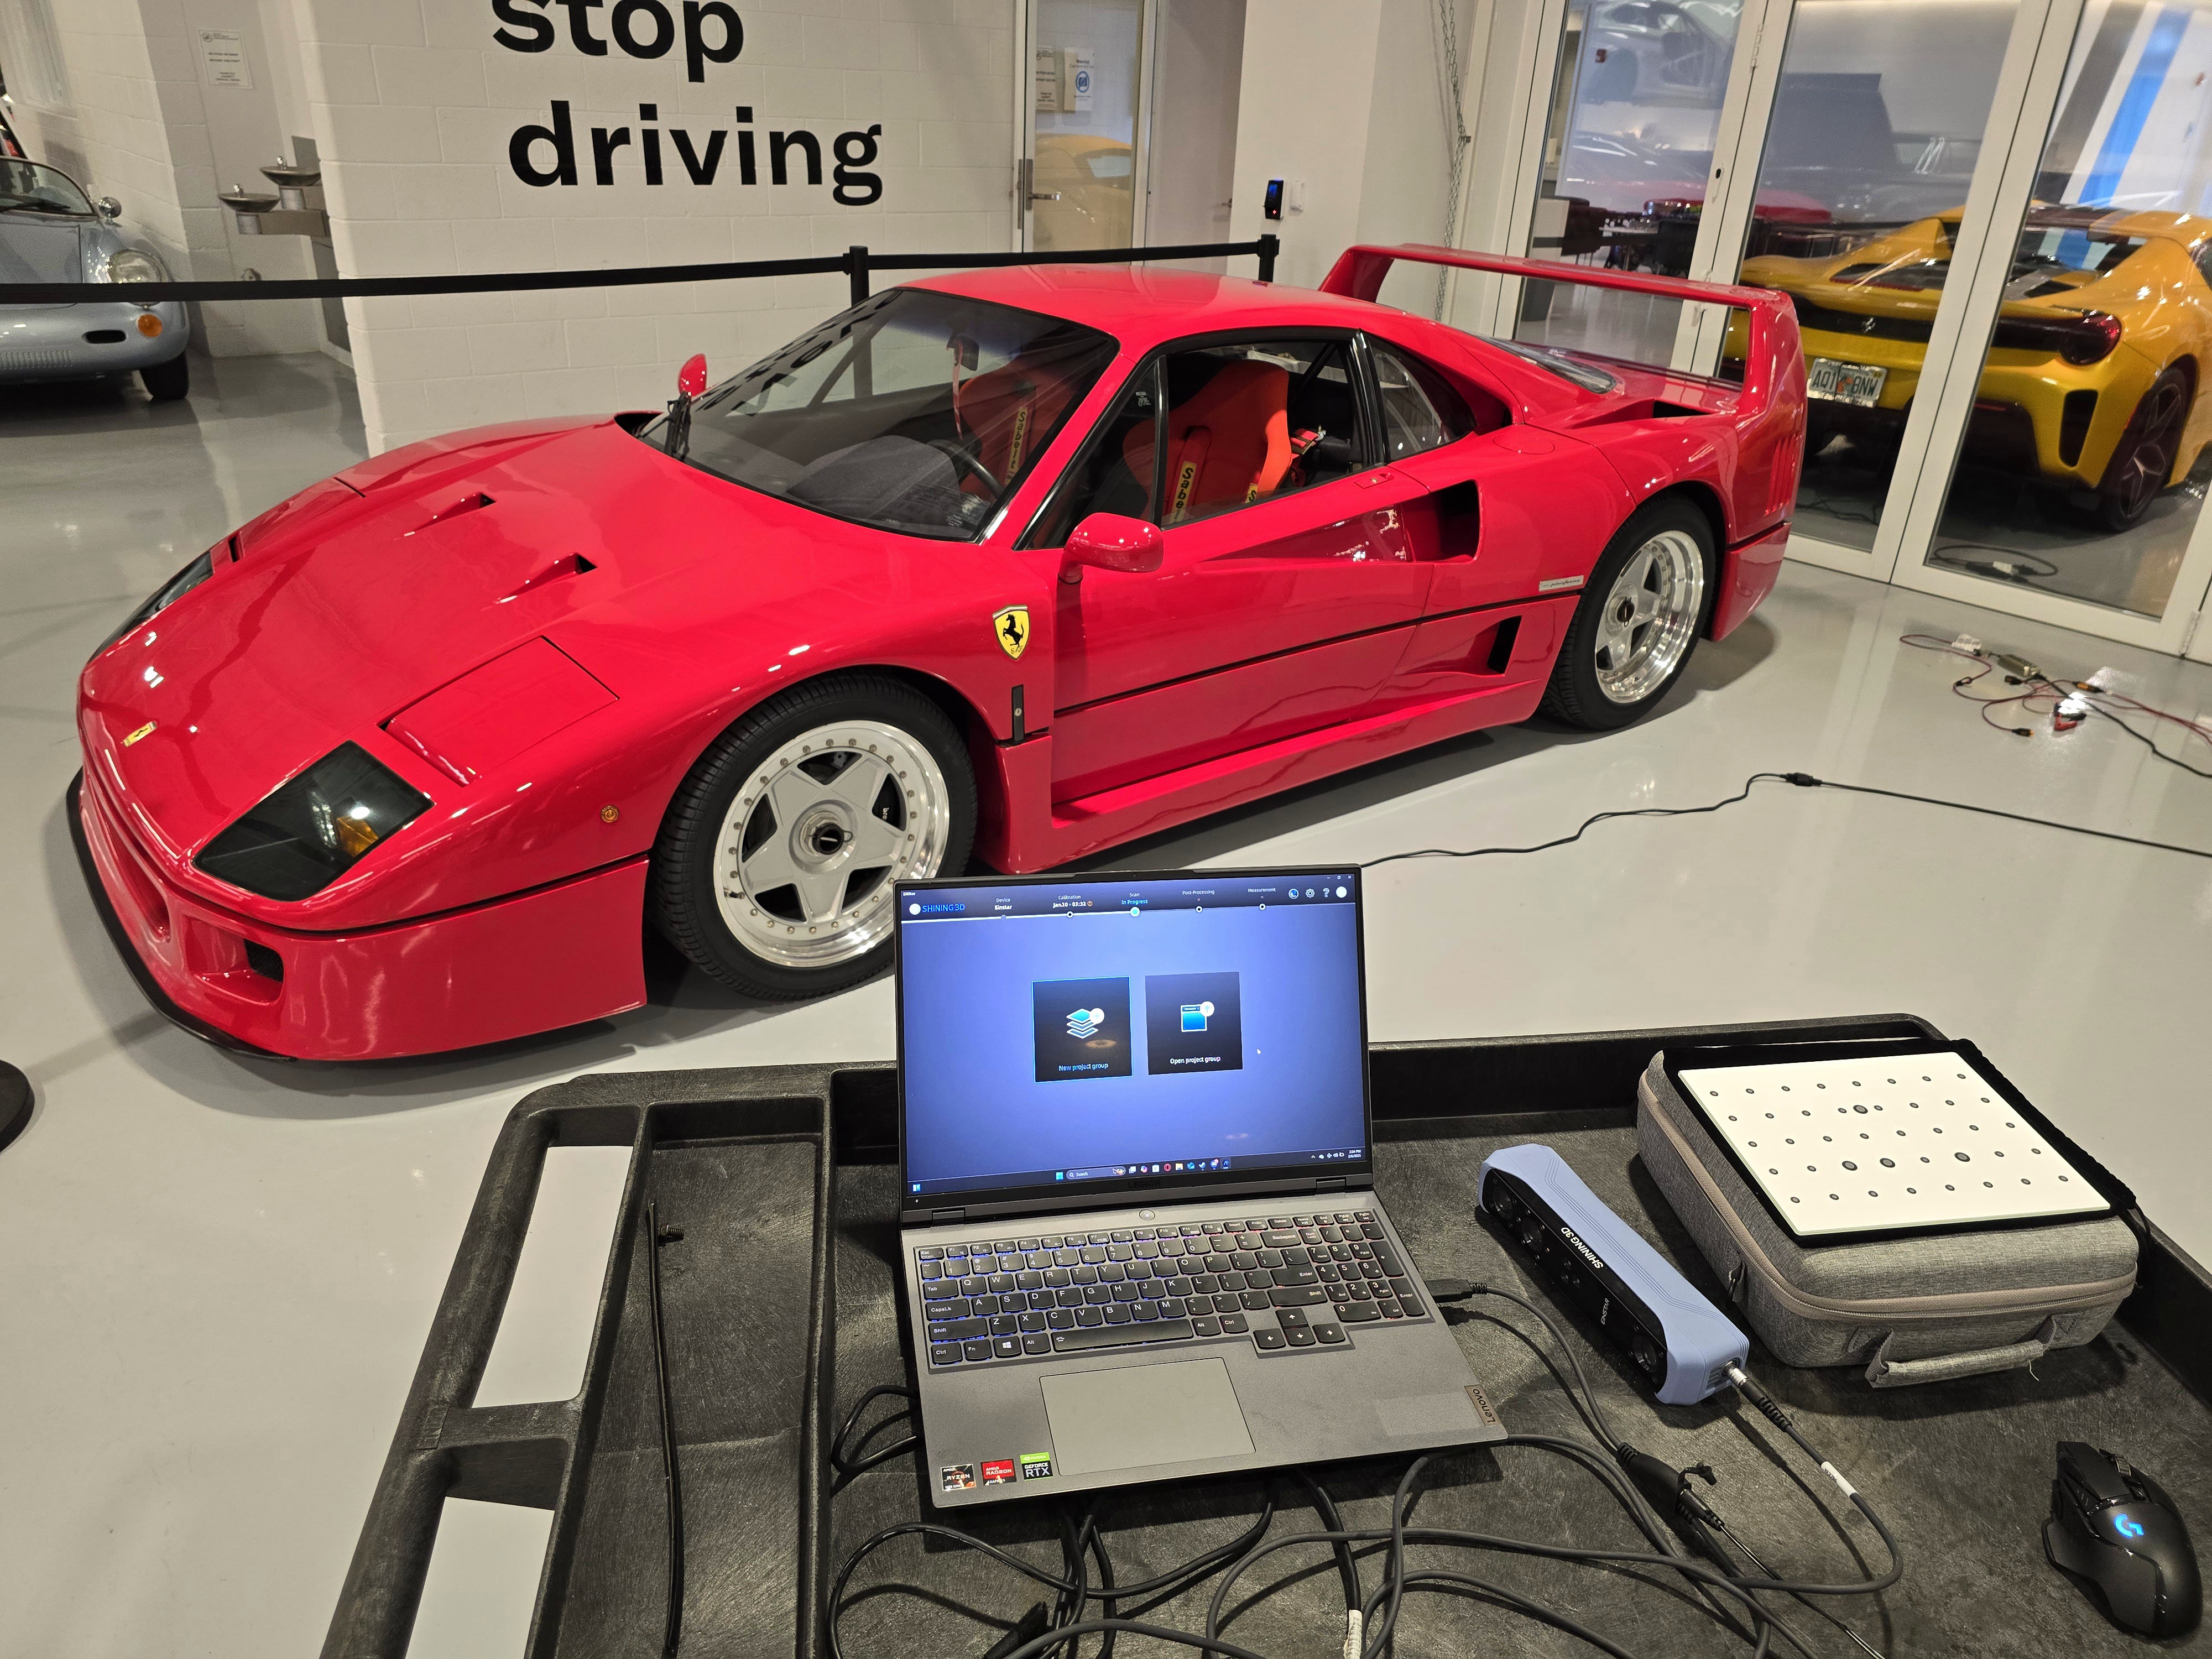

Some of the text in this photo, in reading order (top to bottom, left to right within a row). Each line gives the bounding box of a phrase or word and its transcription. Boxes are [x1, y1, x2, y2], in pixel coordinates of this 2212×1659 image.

[492, 0, 744, 82] stop
[509, 100, 883, 206] driving
[1011, 411, 1026, 469] Sabelt
[1174, 467, 1193, 522] Sabel
[922, 904, 954, 912] SHINING
[1128, 1179, 1161, 1188] LEGION
[1561, 1227, 1604, 1269] SHINING 3D
[1600, 1297, 1610, 1325] EINSTAR
[1473, 1389, 1496, 1423] Lenovo
[1026, 1468, 1050, 1478] RTX
